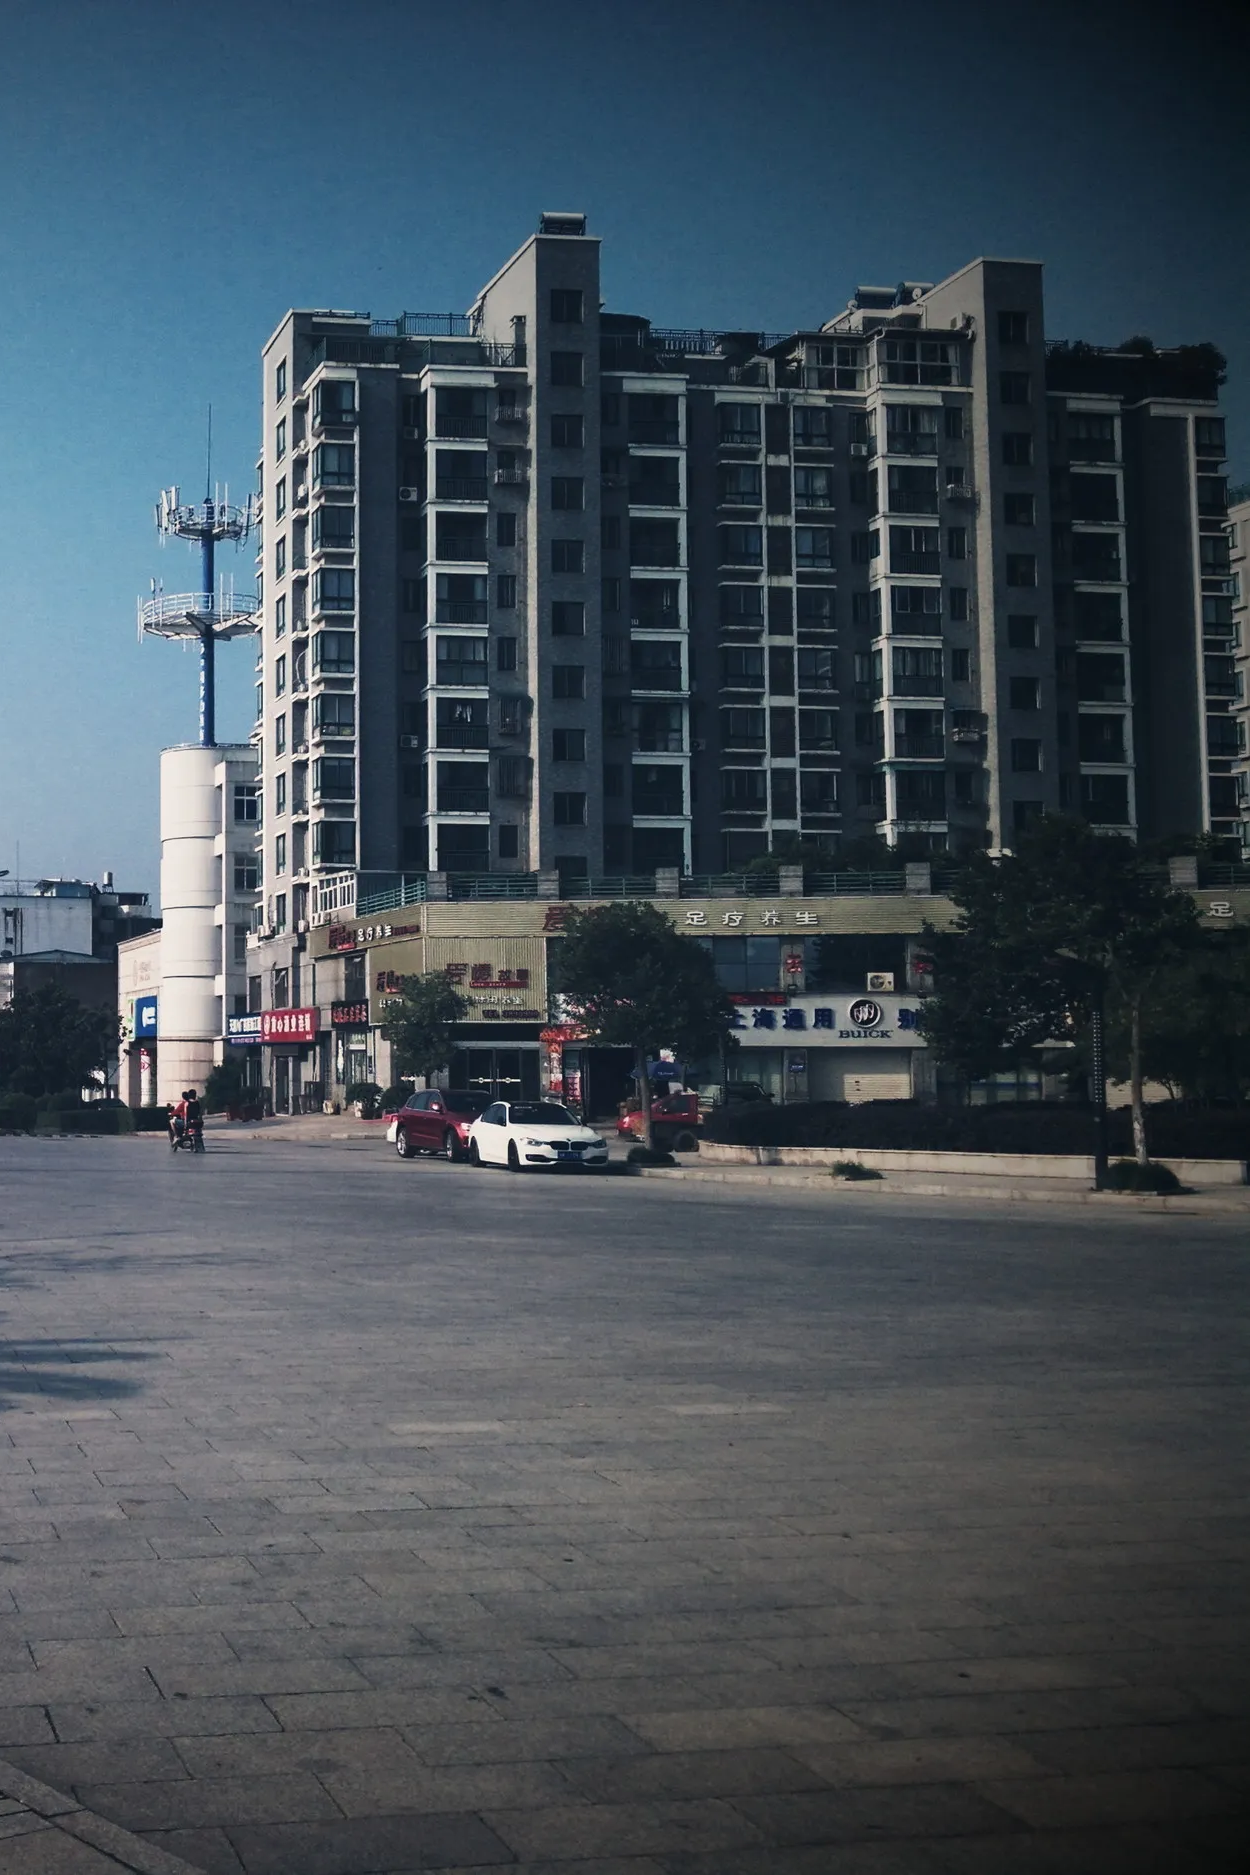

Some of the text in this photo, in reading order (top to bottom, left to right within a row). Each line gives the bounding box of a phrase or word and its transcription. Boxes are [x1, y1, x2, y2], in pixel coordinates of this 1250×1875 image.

[1206, 902, 1234, 917] 足
[685, 911, 819, 927] 足疗养生
[838, 1030, 891, 1039] BUICK
